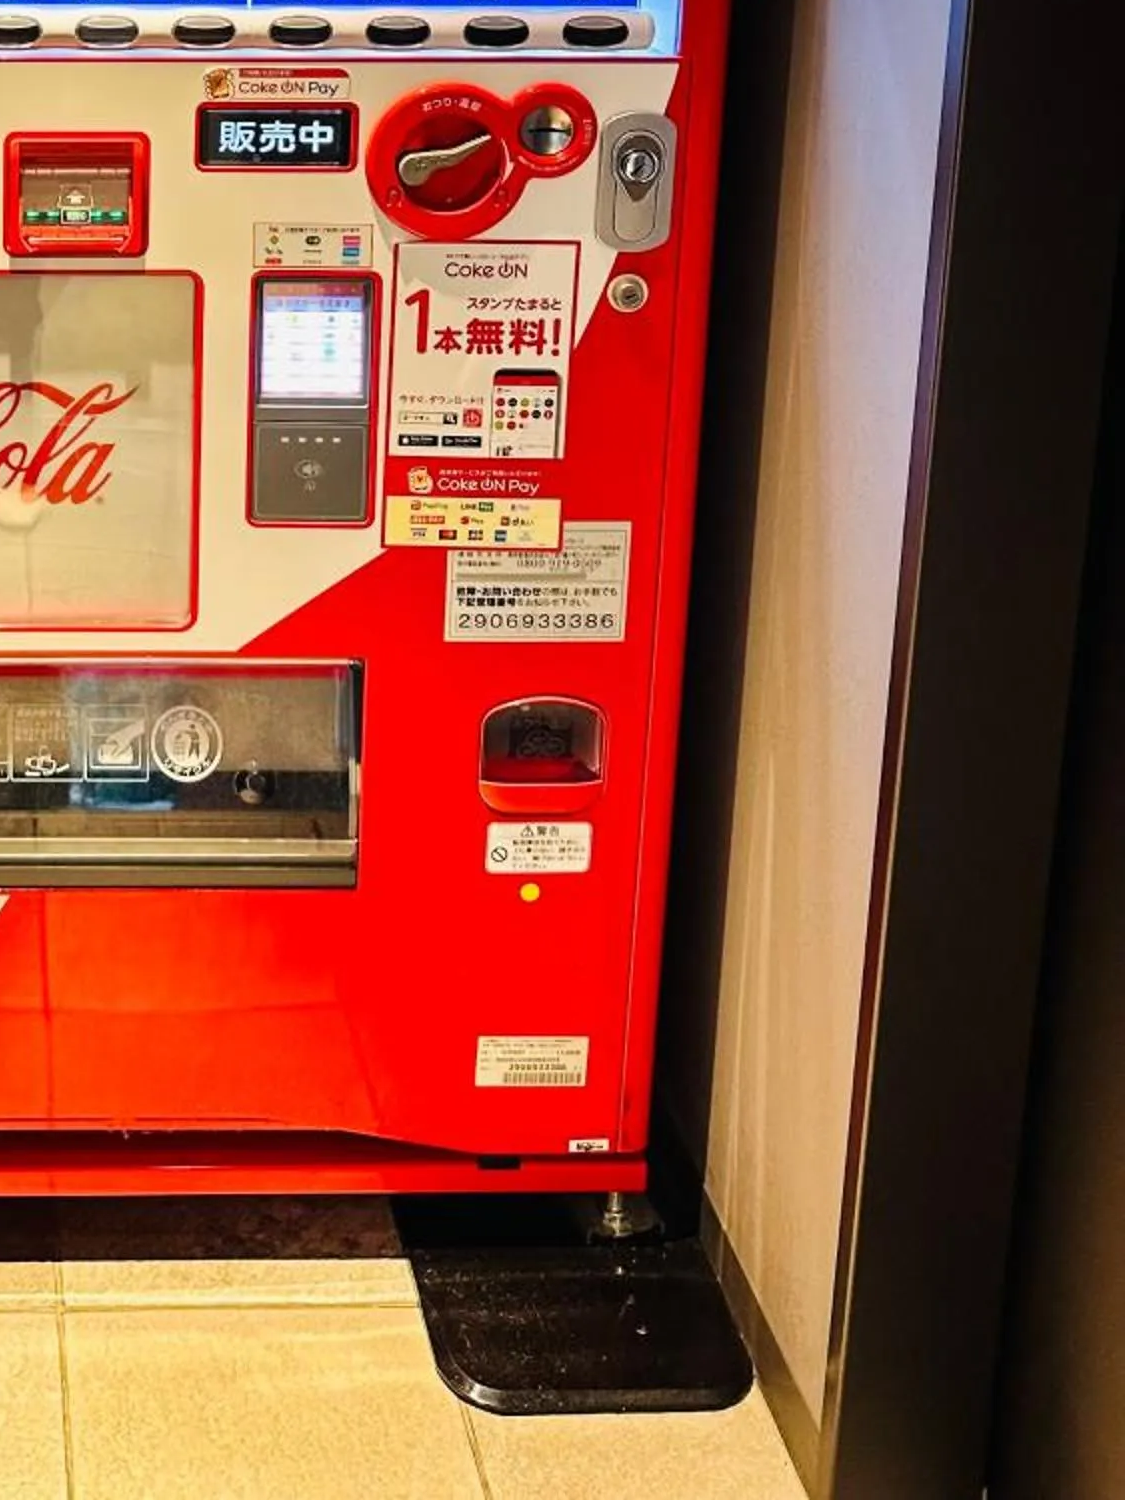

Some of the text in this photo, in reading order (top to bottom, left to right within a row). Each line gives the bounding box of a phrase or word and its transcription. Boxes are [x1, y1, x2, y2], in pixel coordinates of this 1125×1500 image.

[238, 80, 340, 96] Coke ON Pay
[218, 120, 334, 153] 販売中
[444, 262, 528, 279] Coke ON
[466, 297, 562, 312] スタンプたまると
[436, 477, 540, 497] Coke ON Pay
[458, 613, 614, 629] 2906933386
